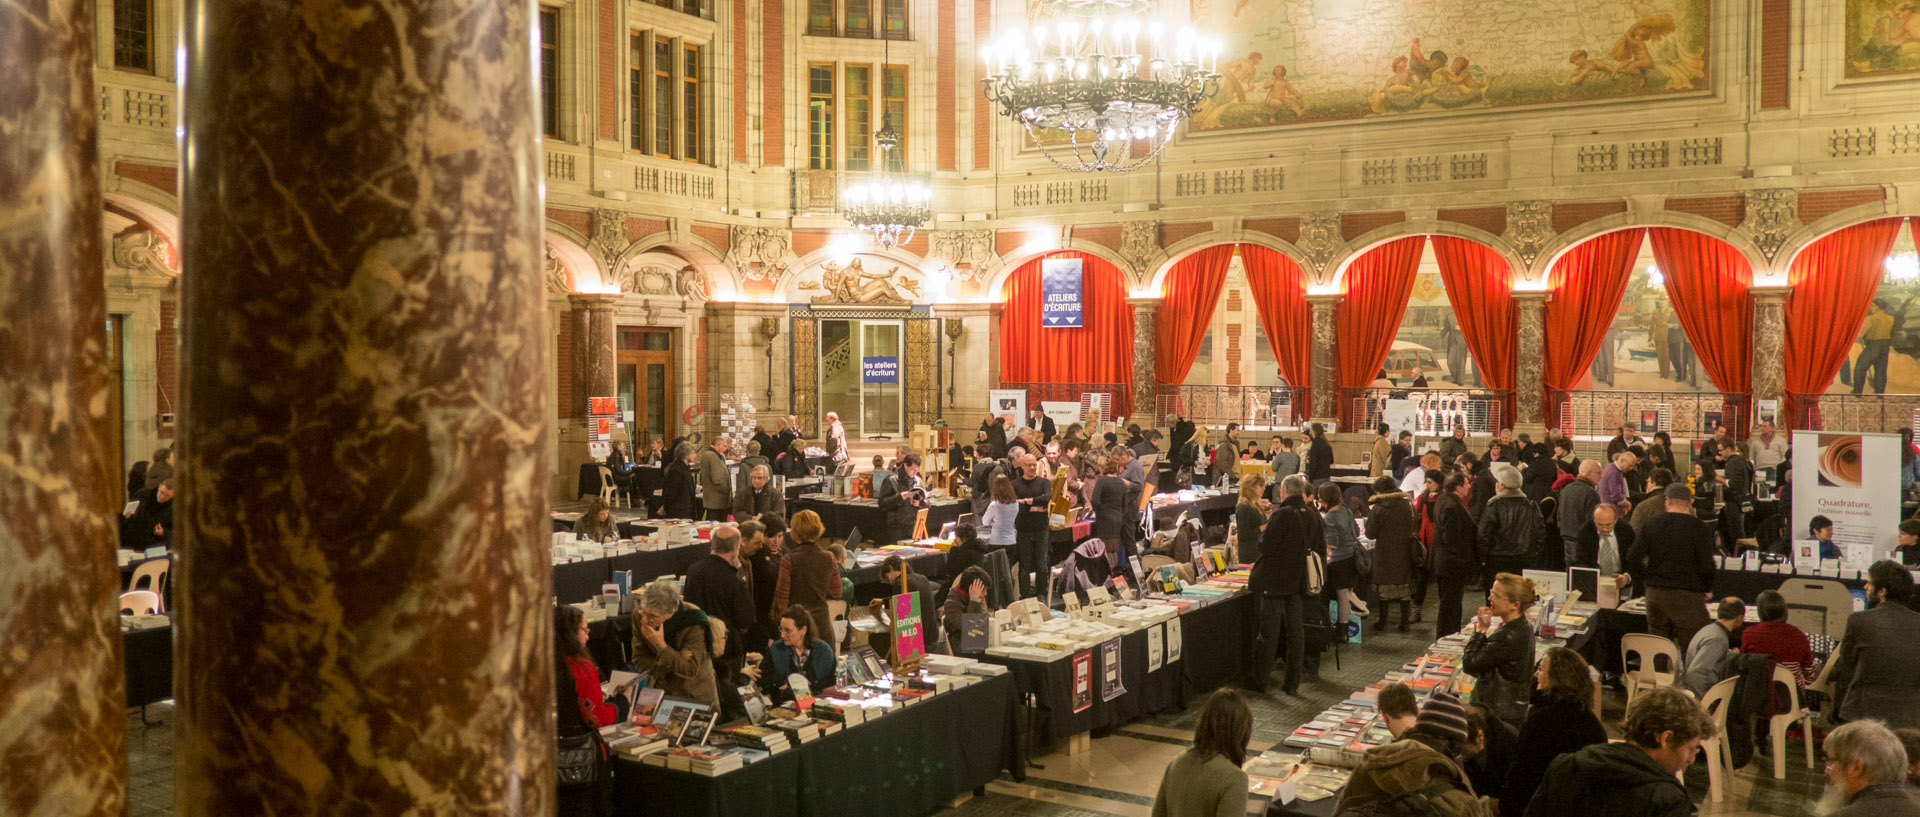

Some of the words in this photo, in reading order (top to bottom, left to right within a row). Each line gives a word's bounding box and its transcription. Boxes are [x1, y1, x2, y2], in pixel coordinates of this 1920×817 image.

[1048, 294, 1077, 302] ATELIERS
[1044, 301, 1081, 312] D'ÉCRITURE
[1818, 498, 1872, 509] Quadrature,
[897, 615, 920, 628] EDITIONS
